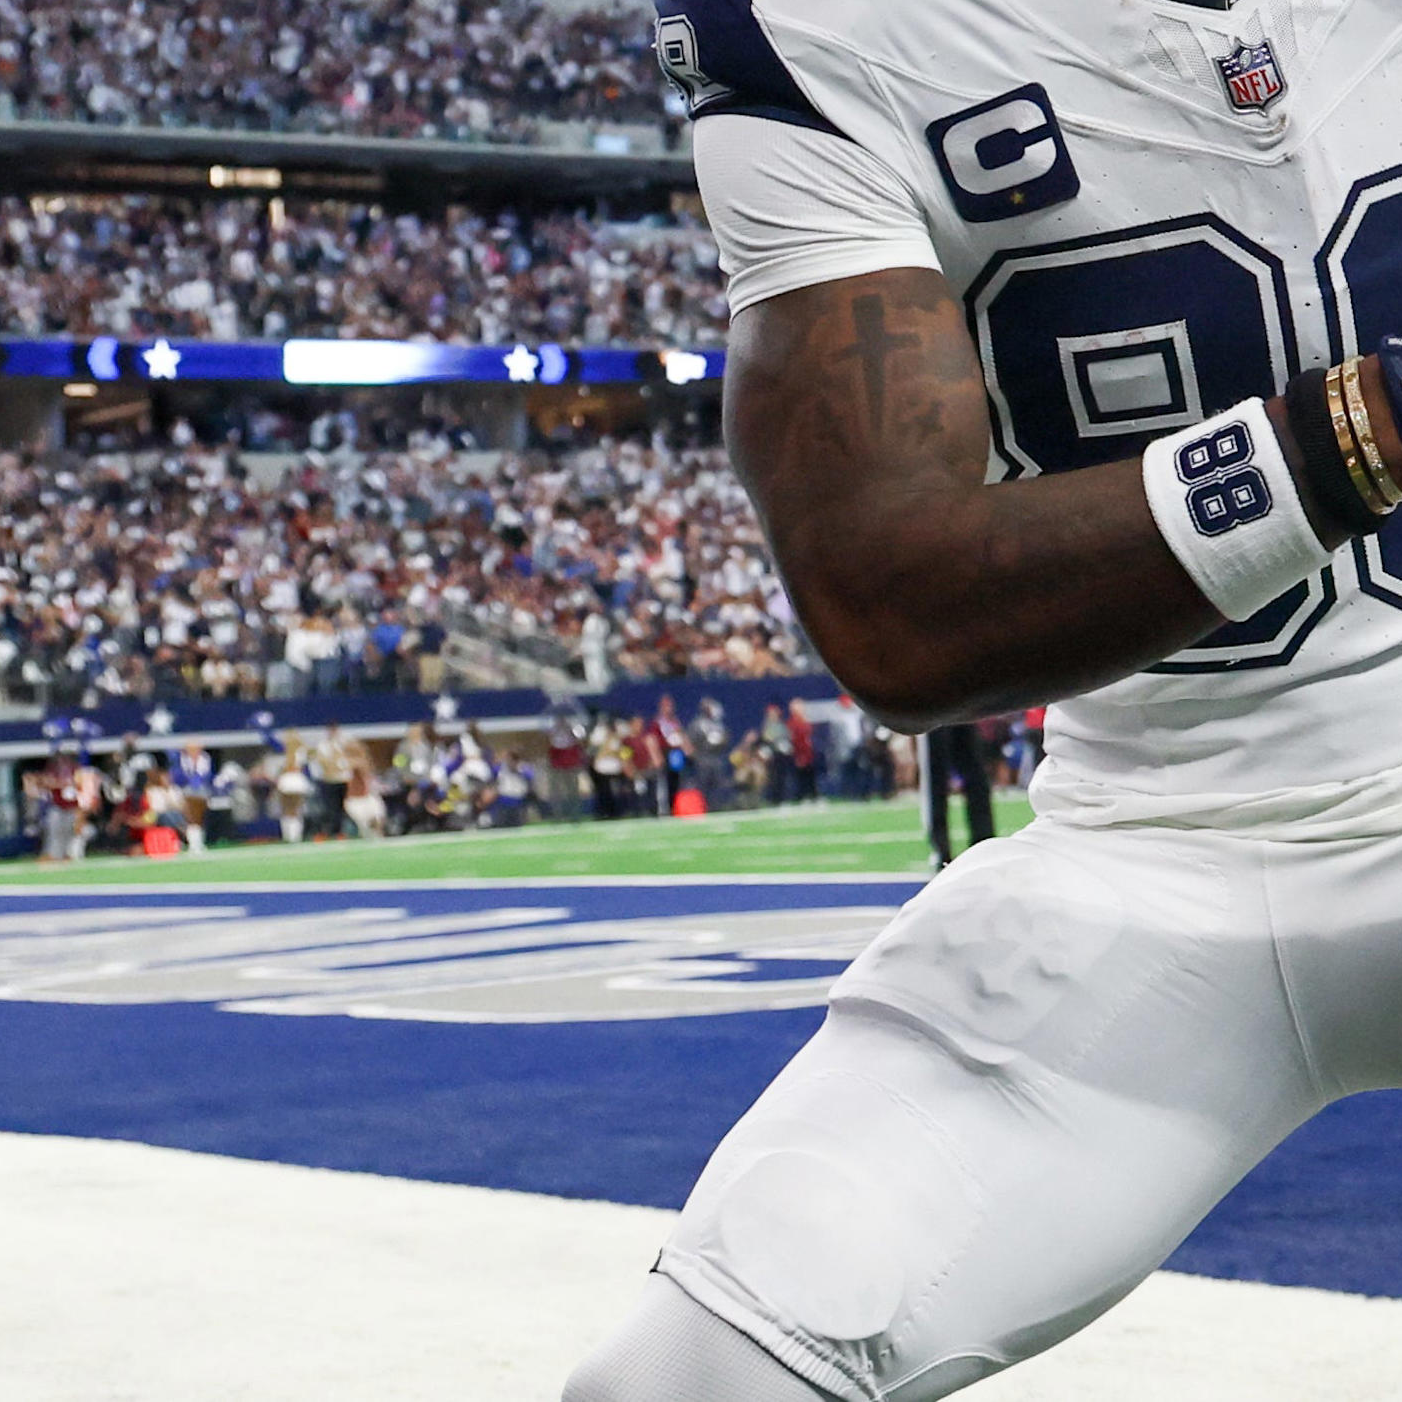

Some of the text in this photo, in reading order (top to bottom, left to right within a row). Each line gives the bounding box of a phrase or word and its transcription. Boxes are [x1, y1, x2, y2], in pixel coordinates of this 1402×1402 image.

[1230, 68, 1279, 104] NFL
[941, 98, 1058, 196] C
[1173, 420, 1273, 538] 88
